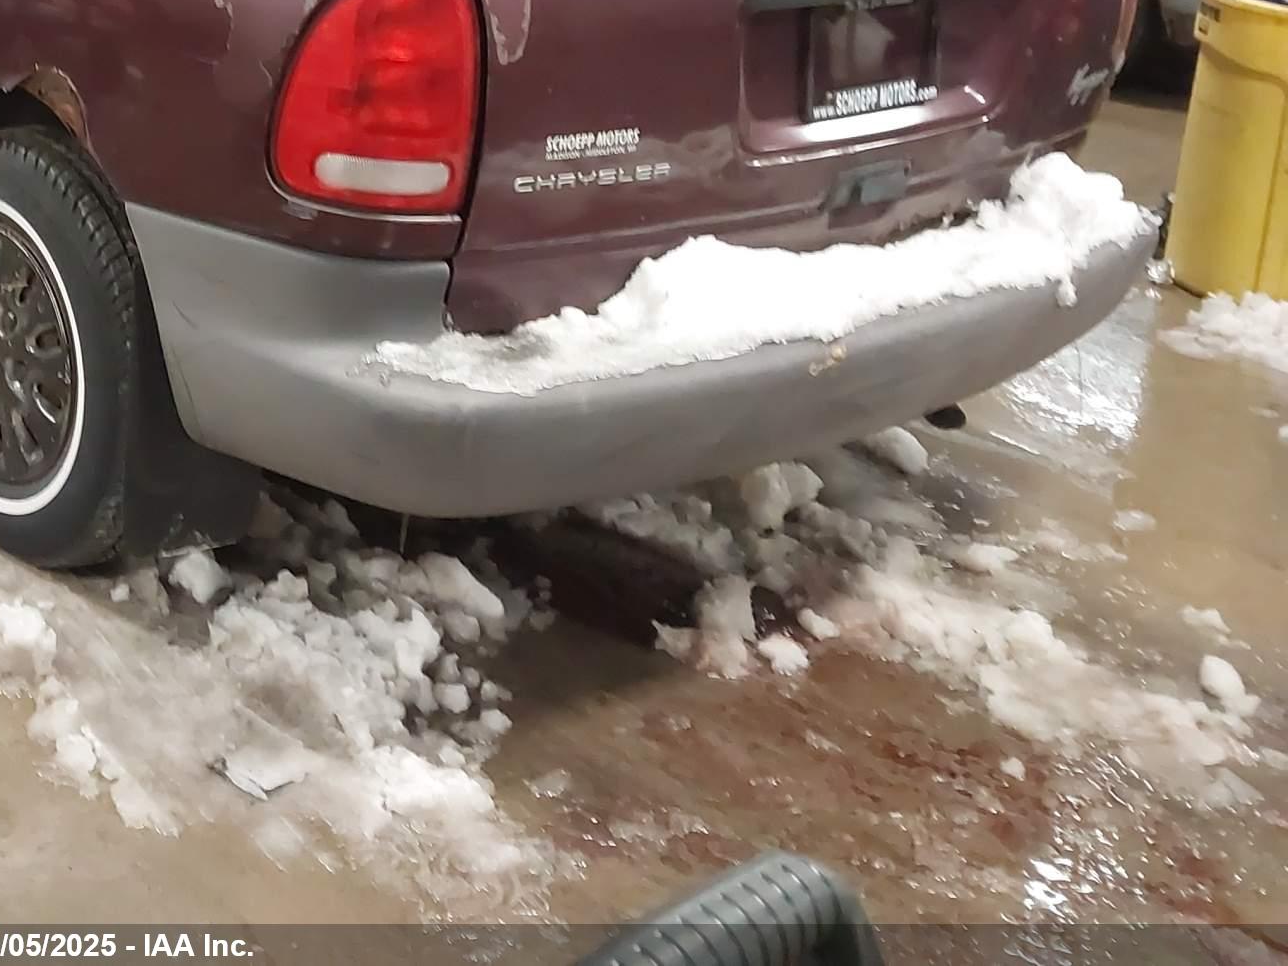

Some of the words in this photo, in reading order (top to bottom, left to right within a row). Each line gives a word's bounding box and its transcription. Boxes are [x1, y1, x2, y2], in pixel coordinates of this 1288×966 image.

[545, 133, 595, 153] SCHOEPP
[595, 127, 641, 147] MOTORS
[513, 162, 672, 193] CHRYSLER
